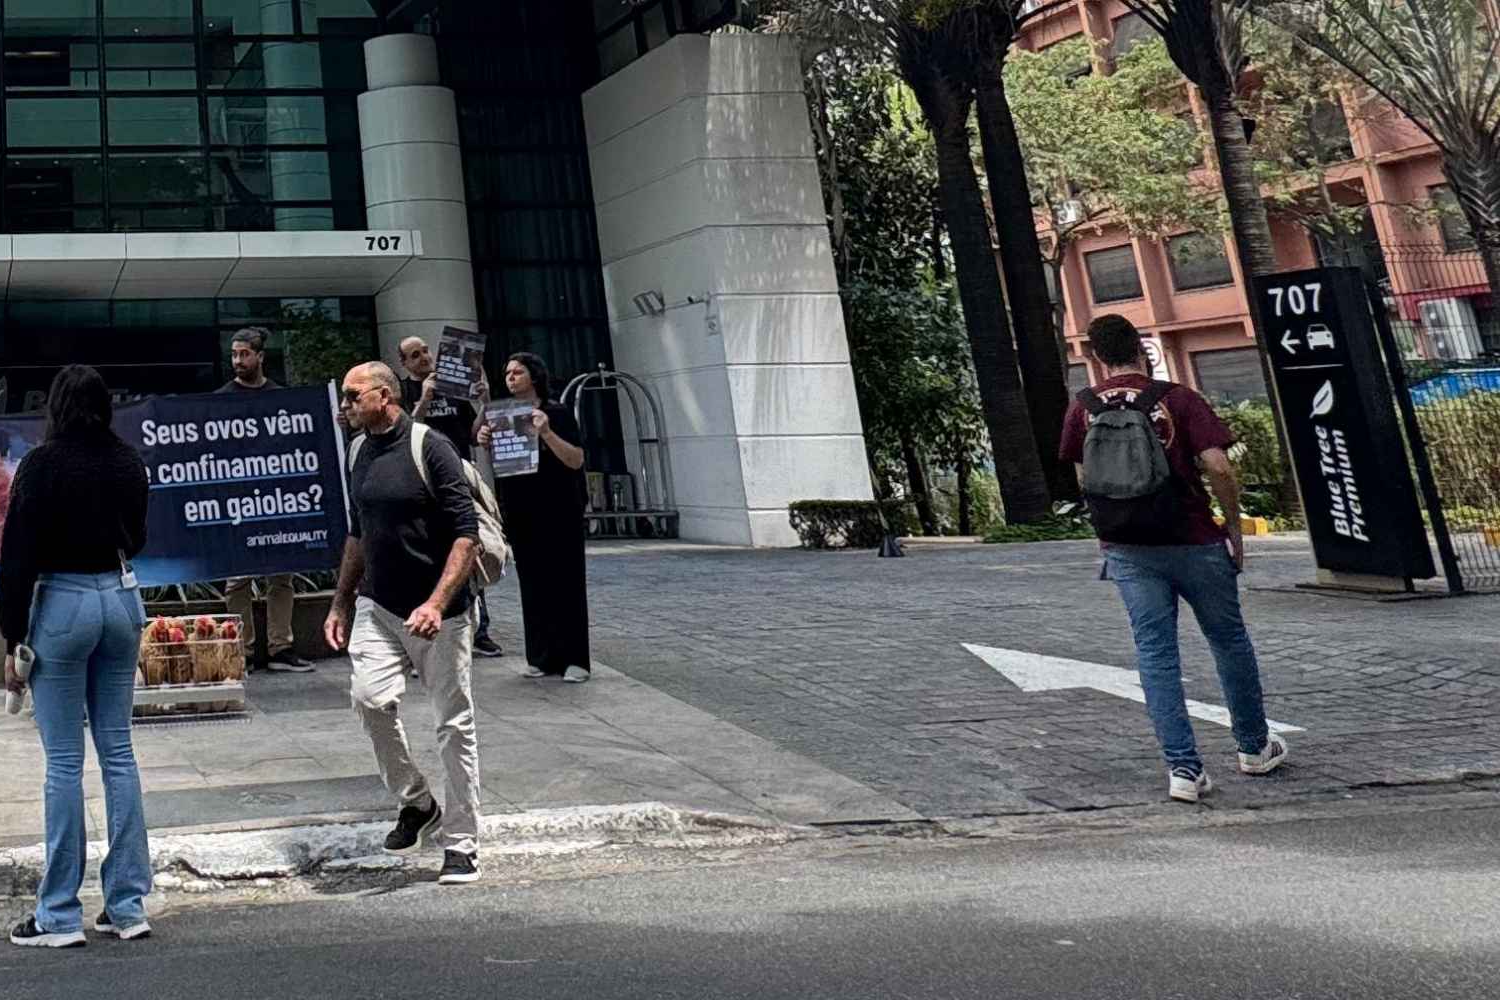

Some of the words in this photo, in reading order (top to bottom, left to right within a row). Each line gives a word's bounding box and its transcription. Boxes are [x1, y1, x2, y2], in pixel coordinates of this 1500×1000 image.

[365, 236, 401, 250] 707
[1267, 283, 1322, 316] 707
[141, 419, 199, 446] Seus
[204, 417, 259, 441] ovos
[264, 409, 314, 435] vêm
[158, 448, 319, 483] confinamento
[1315, 426, 1337, 476] Tree
[184, 499, 220, 521] em
[227, 484, 323, 525] gaiolas?
[1331, 429, 1370, 542] Premium
[1327, 479, 1352, 537] Blue
